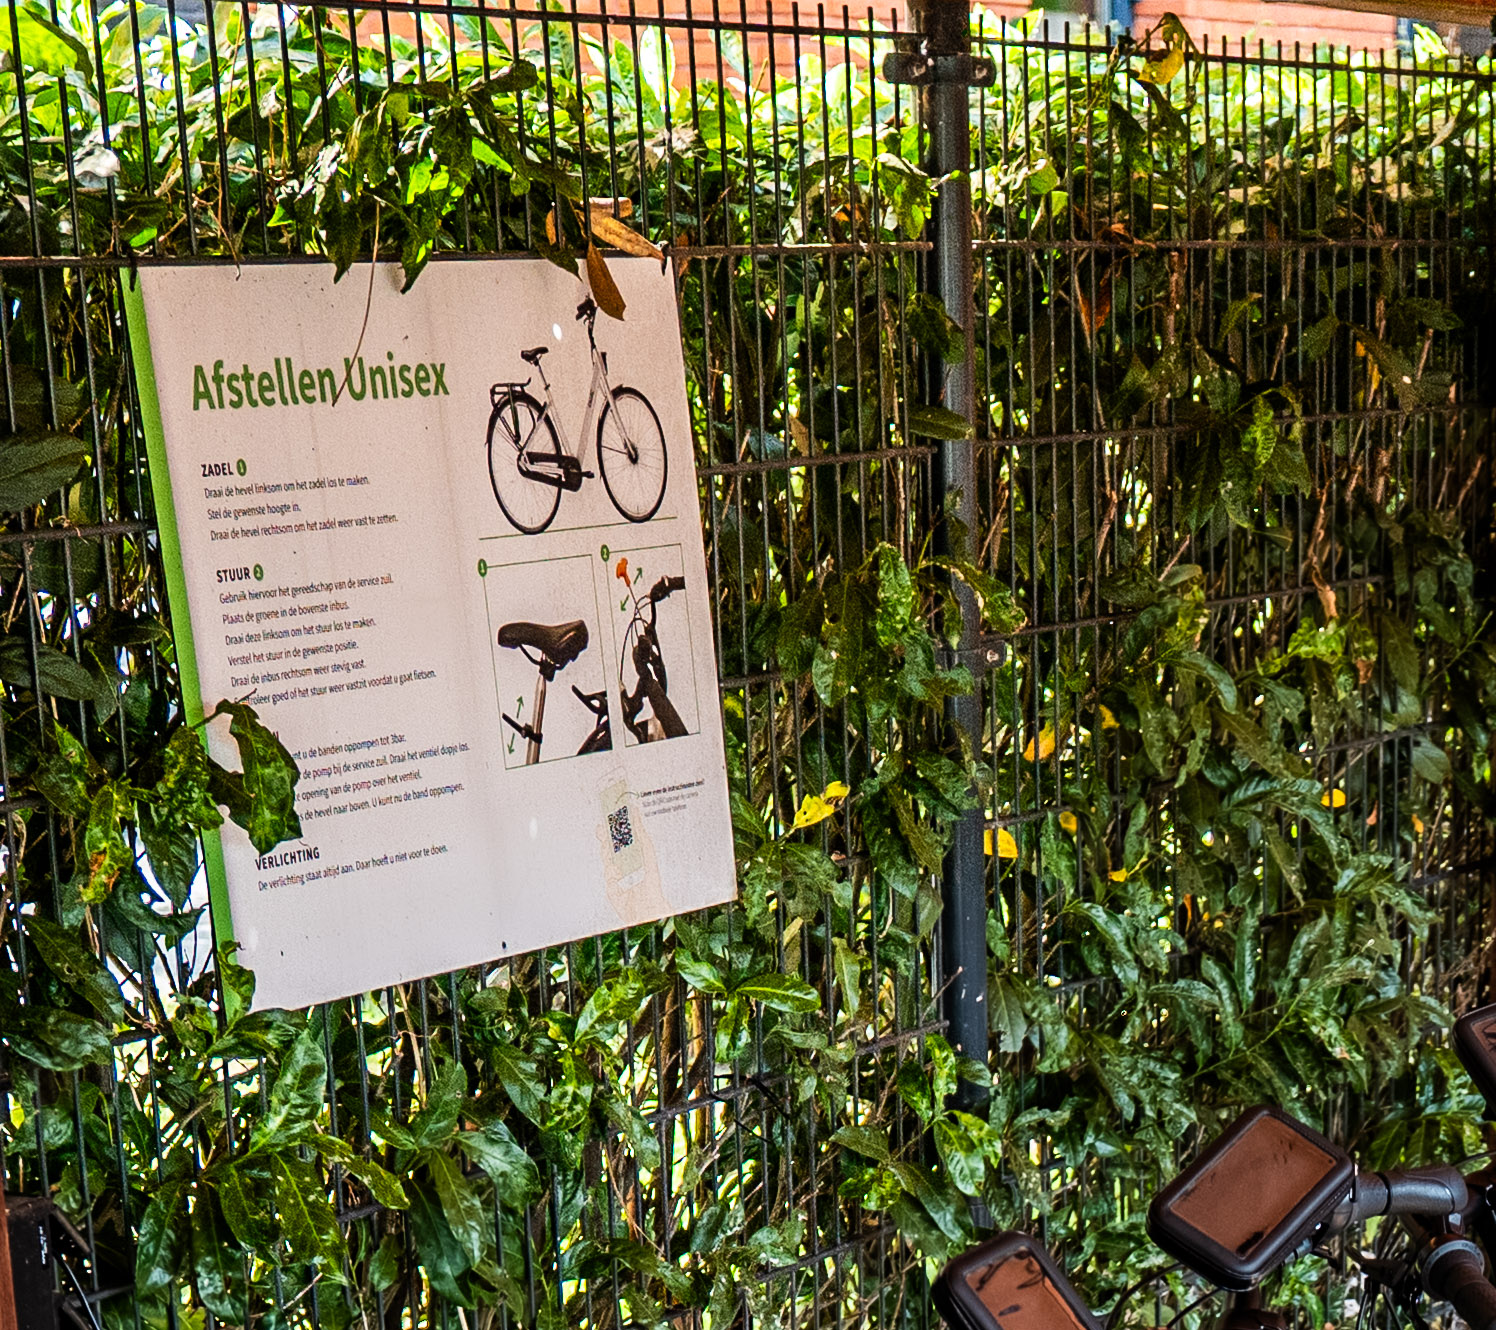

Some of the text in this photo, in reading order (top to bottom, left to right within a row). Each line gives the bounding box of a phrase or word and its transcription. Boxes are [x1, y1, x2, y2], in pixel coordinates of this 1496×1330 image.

[193, 351, 449, 410] Afstellen Unisex
[201, 462, 234, 477] ZADEL
[205, 486, 223, 499] Draai
[225, 485, 234, 497] de
[235, 484, 253, 496] hevel
[255, 482, 282, 494] linksom
[284, 482, 295, 491] om
[296, 480, 307, 490] het
[309, 478, 326, 489] zadel
[327, 477, 337, 488] los
[338, 478, 344, 486] te
[207, 508, 222, 520] Stel
[223, 507, 231, 518] de
[233, 505, 265, 520] gewenste
[266, 503, 290, 516] hoogte
[211, 529, 229, 541] Draai
[231, 528, 239, 538] de
[241, 525, 259, 537] hevel
[261, 524, 292, 535] rechtsom
[294, 524, 305, 532] om
[306, 520, 317, 531] het
[319, 518, 336, 530] zadel
[337, 519, 353, 528] weer
[355, 516, 368, 526] vast
[369, 515, 375, 525] te
[216, 567, 251, 583] STUUR
[220, 591, 246, 604] Gebruik
[248, 588, 277, 600] hiervoor
[278, 586, 290, 596] het
[291, 582, 333, 598] gereedschap
[334, 581, 346, 590] van
[347, 578, 356, 588] de
[357, 578, 379, 587] service
[223, 613, 244, 624] Plaats
[245, 611, 254, 622] de
[255, 610, 279, 623] groene
[281, 607, 287, 617] in
[289, 607, 297, 616] de
[298, 604, 328, 615] bovenste
[225, 633, 244, 645] Draai
[245, 632, 261, 642] deze
[262, 629, 289, 640] linksom
[291, 628, 302, 636] om
[303, 625, 313, 635] het
[315, 623, 332, 632] stuur
[333, 620, 343, 631] los
[344, 621, 351, 629] te
[227, 640, 358, 666] Verstel het stuur in de gewenste positie.
[231, 675, 250, 687] Draai
[251, 673, 259, 684] de
[261, 672, 280, 683] inbus
[281, 668, 312, 680] rechtsom
[314, 666, 329, 675] weer
[331, 661, 350, 673] stevig
[272, 690, 288, 705] goed
[290, 687, 297, 698] of
[298, 689, 309, 697] het
[310, 686, 327, 696] stuur
[329, 684, 344, 693] weer
[346, 679, 367, 690] vastzit
[368, 675, 393, 687] voordat
[399, 674, 413, 685] gaat
[303, 751, 307, 759] u
[308, 748, 317, 758] de
[318, 744, 343, 756] banden
[345, 739, 379, 754] oppompen
[380, 737, 389, 745] tot
[303, 769, 311, 779] de
[313, 767, 332, 781] pomp
[333, 764, 341, 776] bij
[343, 762, 351, 772] de
[352, 759, 374, 771] service
[389, 752, 406, 764] Draai
[407, 750, 417, 760] het
[419, 746, 440, 759] ventiel
[441, 744, 457, 755] dopje
[302, 787, 329, 800] opening
[330, 786, 341, 795] van
[343, 782, 351, 793] de
[352, 780, 371, 793] pomp
[373, 778, 386, 787] over
[387, 773, 398, 784] het
[305, 810, 313, 820] de
[315, 805, 332, 818] hevel
[334, 805, 348, 814] naar
[372, 798, 377, 807] U
[378, 795, 392, 805] kunt
[404, 792, 411, 801] de
[412, 787, 428, 799] band
[255, 847, 320, 870] VERLICHTING
[258, 881, 268, 891] De
[269, 874, 304, 888] verlichting
[305, 873, 322, 881] staat
[323, 865, 339, 879] altijd
[356, 861, 370, 871] Daar
[371, 854, 388, 868] hoeft
[395, 852, 407, 862] niet
[408, 850, 422, 859] voor
[423, 848, 429, 856] te
